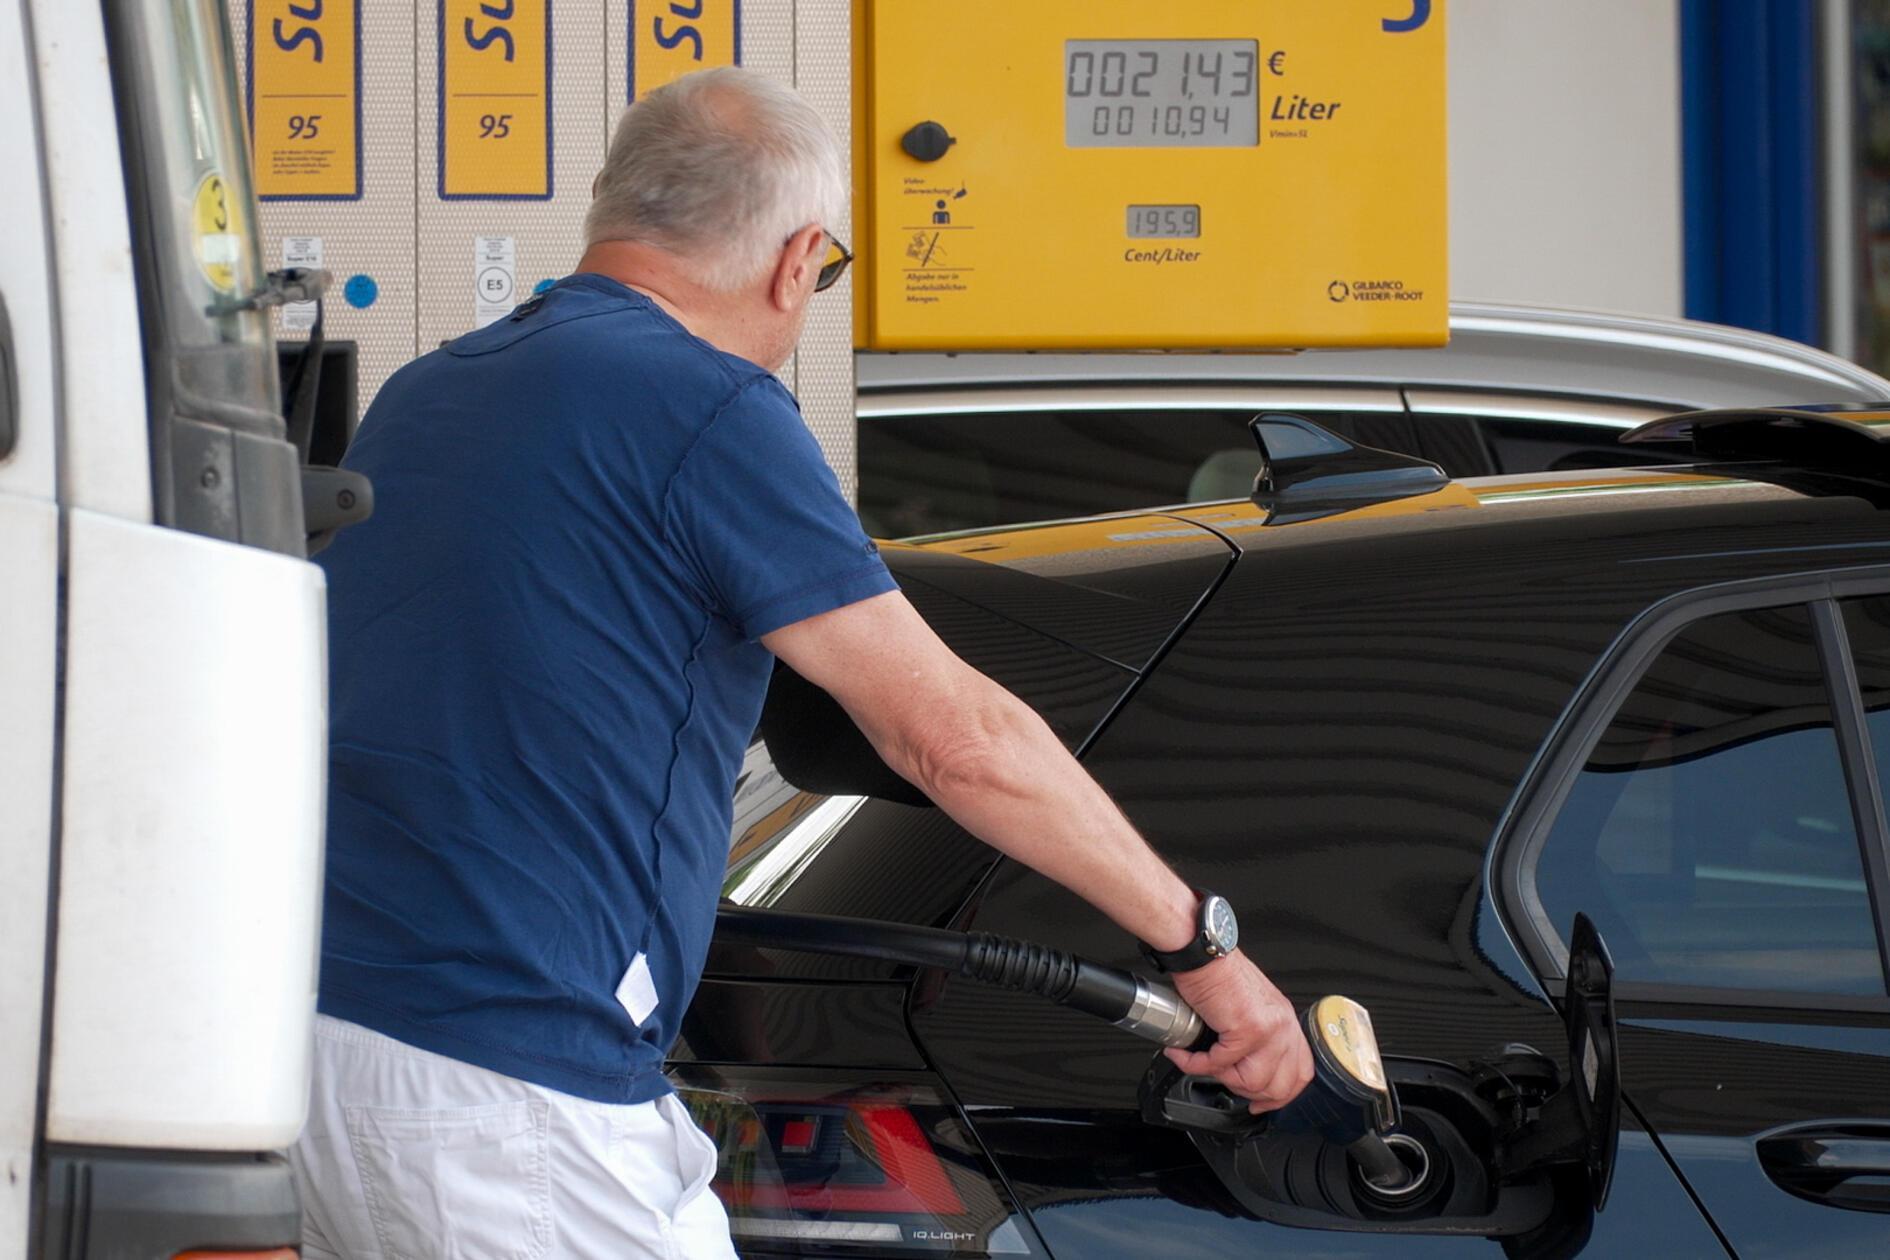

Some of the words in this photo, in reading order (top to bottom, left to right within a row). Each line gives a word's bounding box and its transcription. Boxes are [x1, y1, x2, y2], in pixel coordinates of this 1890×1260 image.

[1067, 51, 1254, 100] 0021,43
[1267, 50, 1286, 76] €
[1271, 95, 1341, 120] Liter
[287, 114, 322, 140] 95
[478, 114, 513, 139] 95
[1092, 105, 1230, 138] 0010,94
[1135, 210, 1196, 236] 195,9
[1124, 248, 1201, 265] Cent/Liter
[487, 279, 504, 291] E5
[1352, 281, 1404, 291] GILBARCO
[1353, 291, 1424, 302] VEEDER-ROOT
[913, 1231, 976, 1241] IQ.LIGHT
